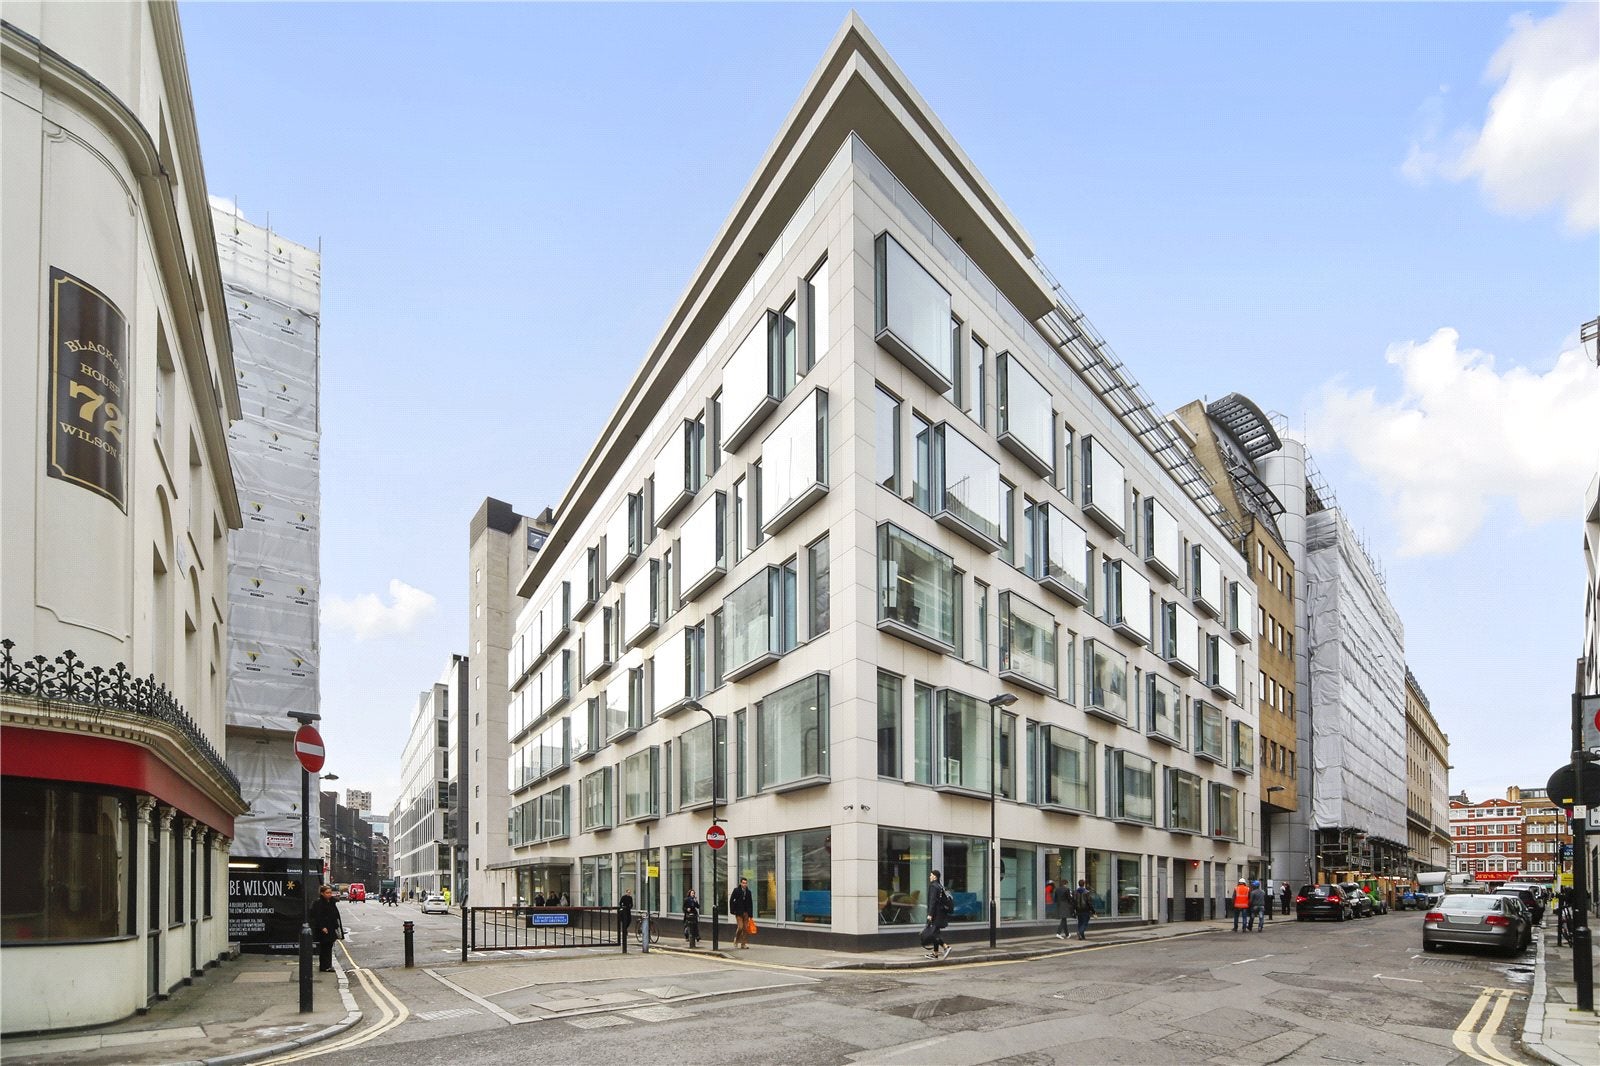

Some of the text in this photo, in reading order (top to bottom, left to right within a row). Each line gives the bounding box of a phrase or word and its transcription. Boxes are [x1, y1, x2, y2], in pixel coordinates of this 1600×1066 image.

[80, 362, 121, 398] HOUSE
[69, 380, 126, 443] 72
[59, 421, 118, 459] WILSON
[229, 880, 241, 896] BE
